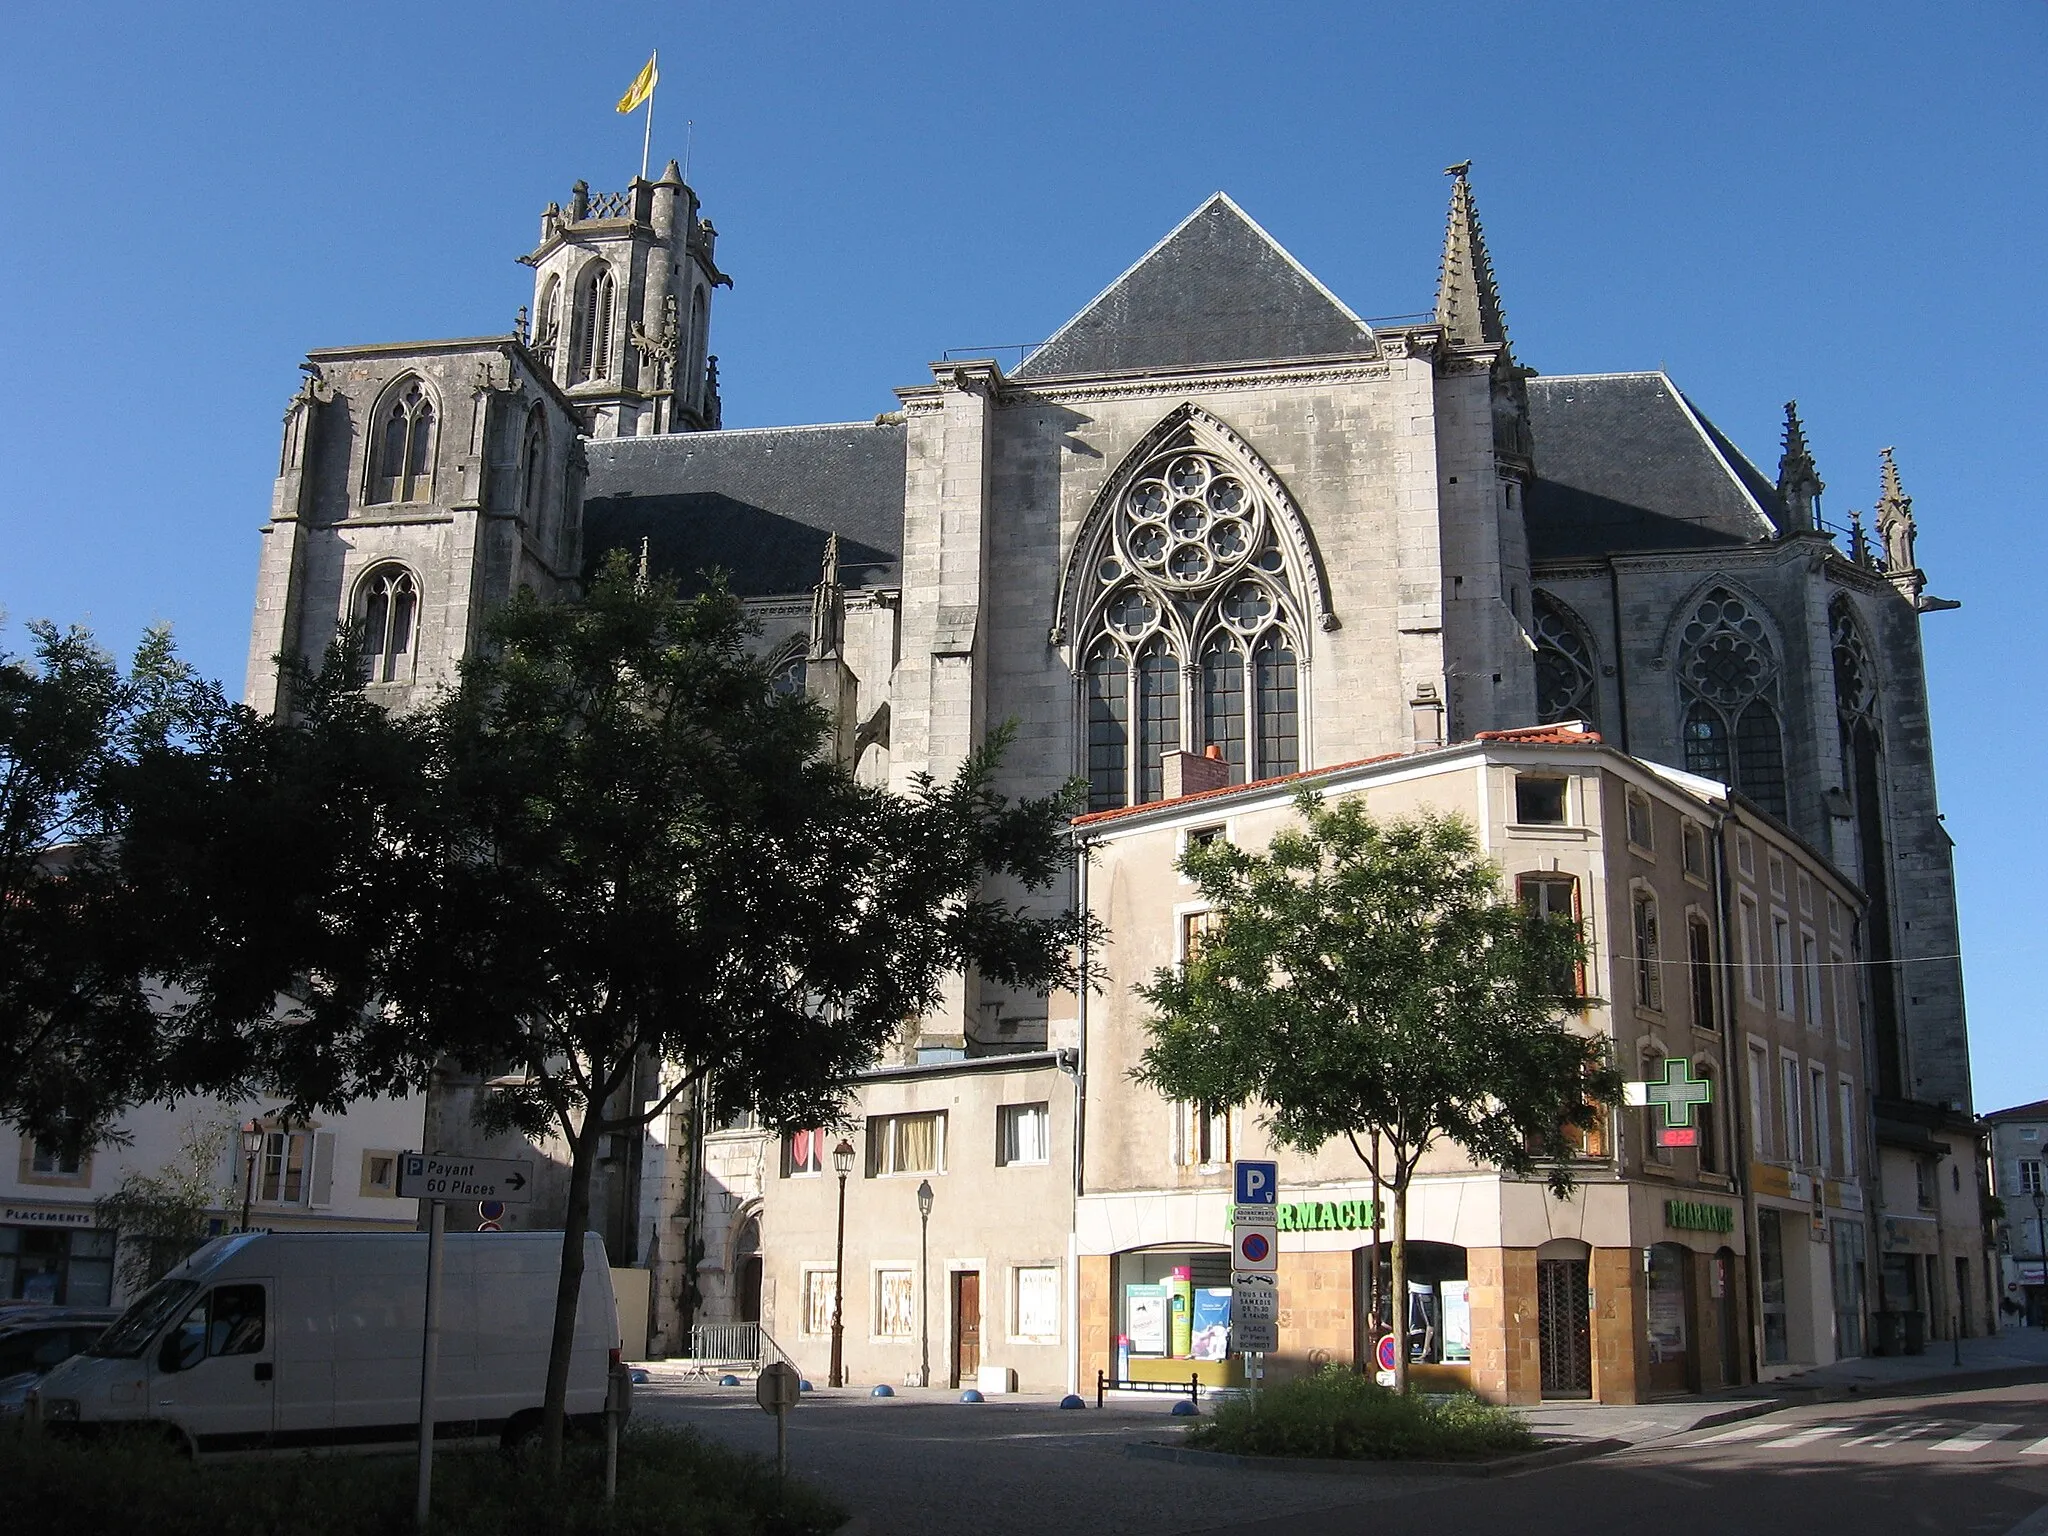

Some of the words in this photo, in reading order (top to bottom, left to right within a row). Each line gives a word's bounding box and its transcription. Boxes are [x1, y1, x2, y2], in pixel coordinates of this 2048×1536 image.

[410, 1160, 421, 1174] P
[427, 1161, 475, 1177] Payant
[427, 1179, 446, 1193] 60
[451, 1181, 496, 1196] Places
[1247, 1170, 1265, 1197] P
[1668, 1199, 1733, 1233] PHARMACIE
